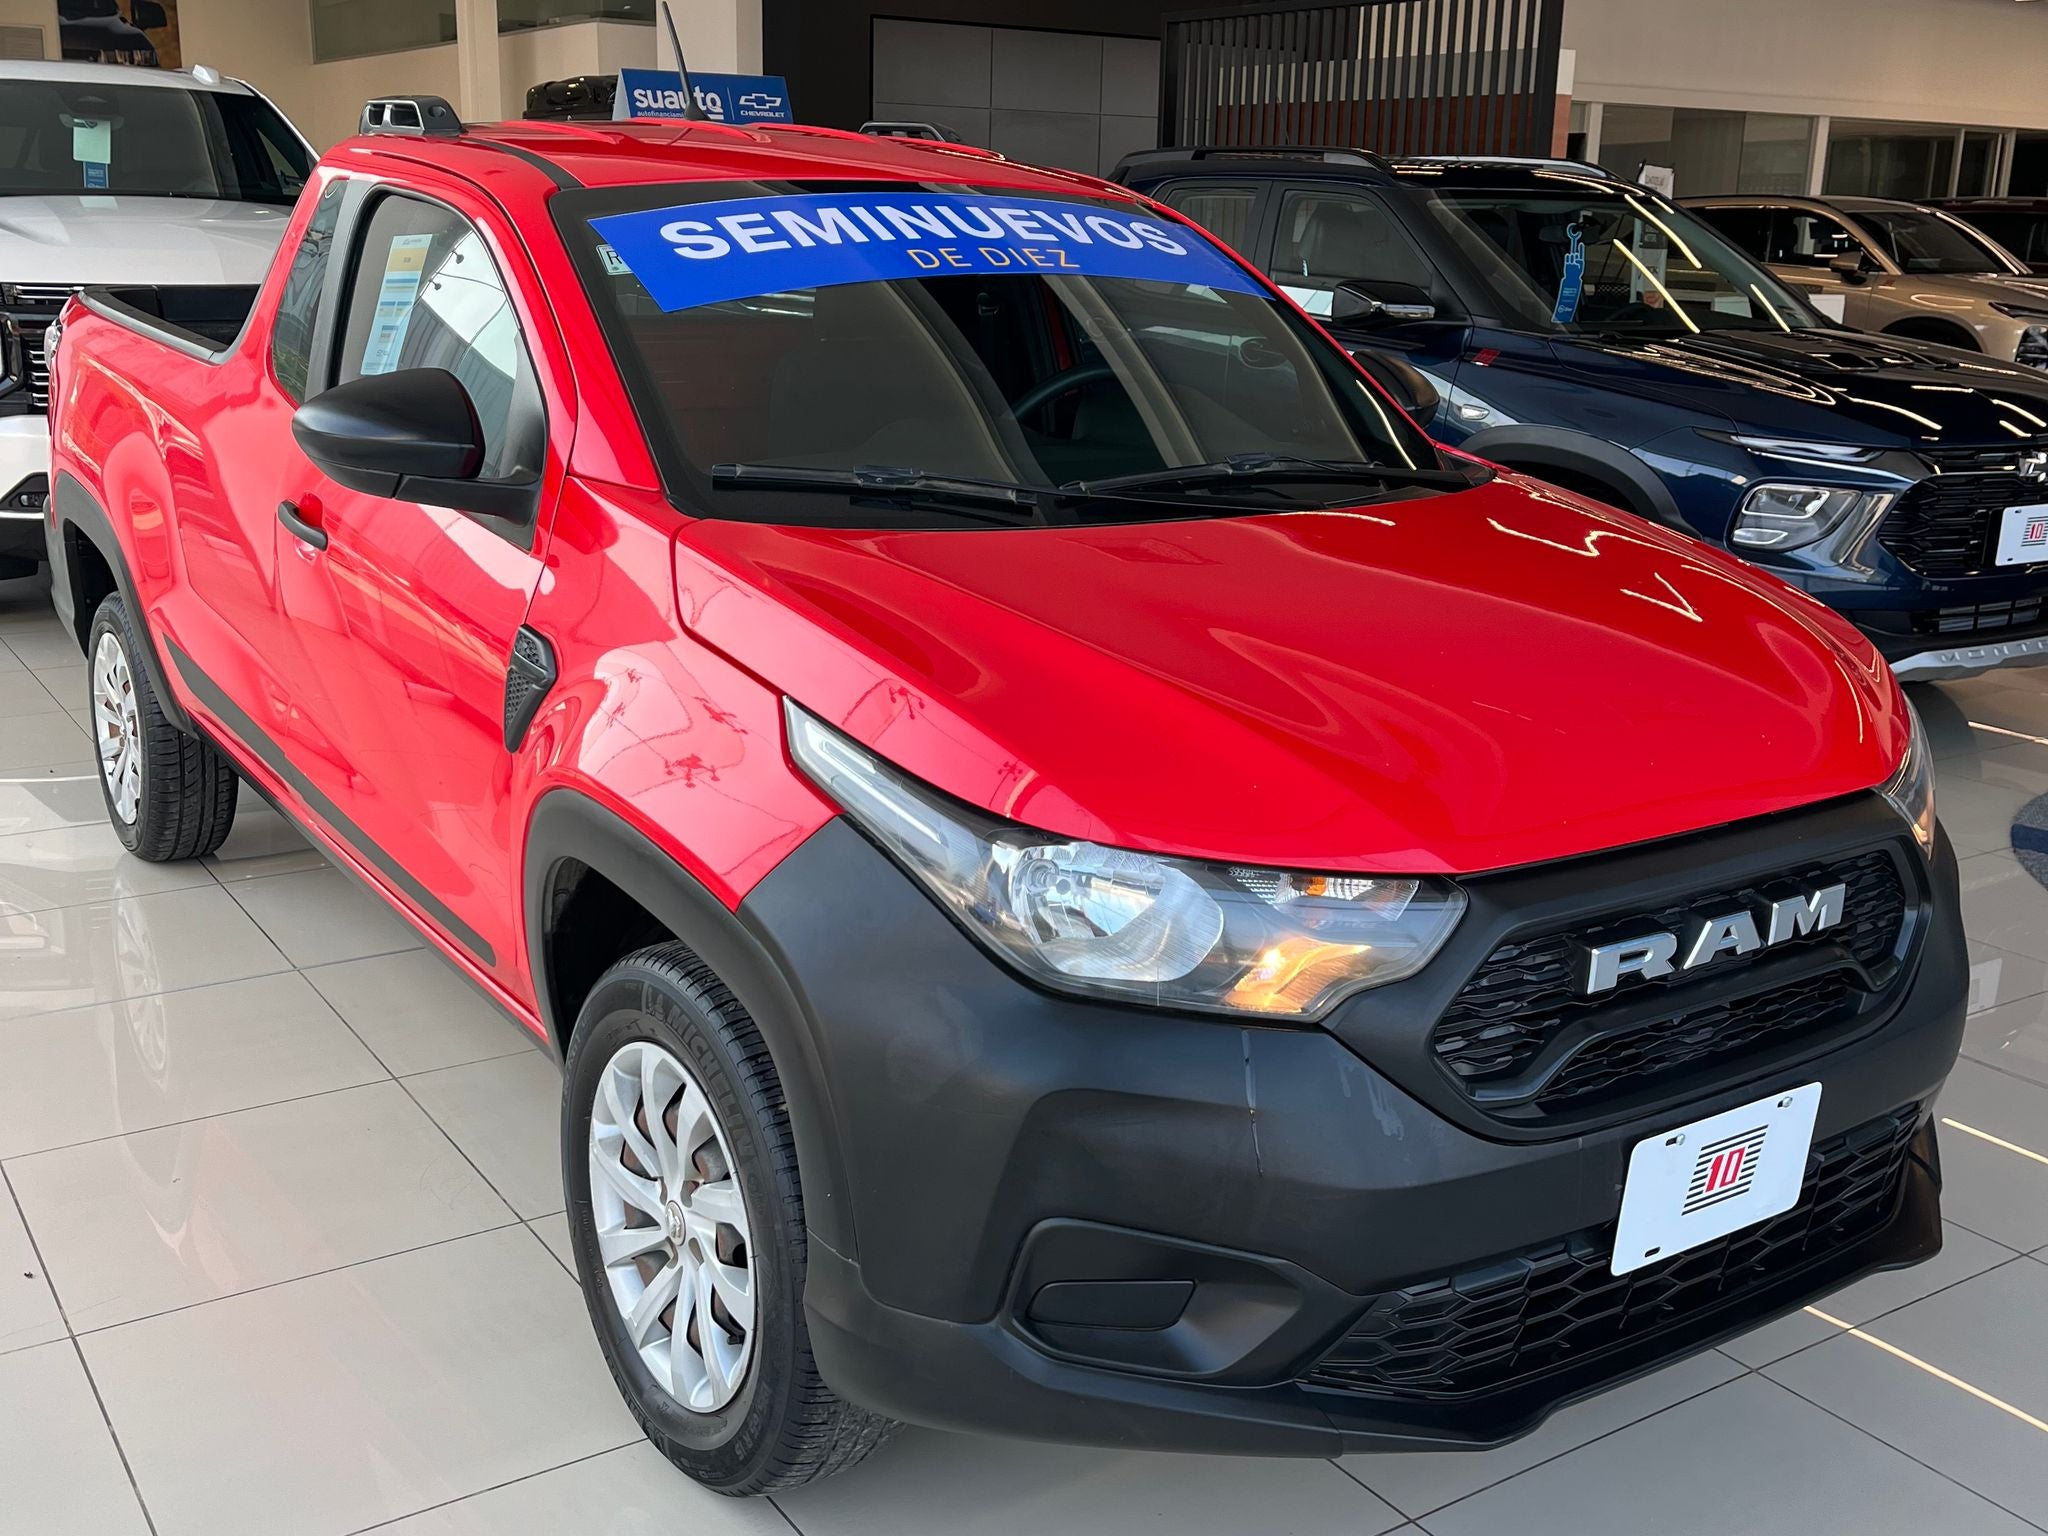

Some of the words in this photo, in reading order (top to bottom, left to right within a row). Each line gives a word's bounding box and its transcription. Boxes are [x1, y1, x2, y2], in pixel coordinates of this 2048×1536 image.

[740, 109, 785, 118] CHEVROLET
[659, 205, 1188, 259] SEMINUEVOS
[906, 247, 973, 269] DE
[978, 247, 1081, 268] DIEZ
[2029, 523, 2044, 540] 10
[1587, 882, 1846, 995] RAM
[667, 1003, 757, 1157] MICHELIN
[1705, 1146, 1746, 1193] 10
